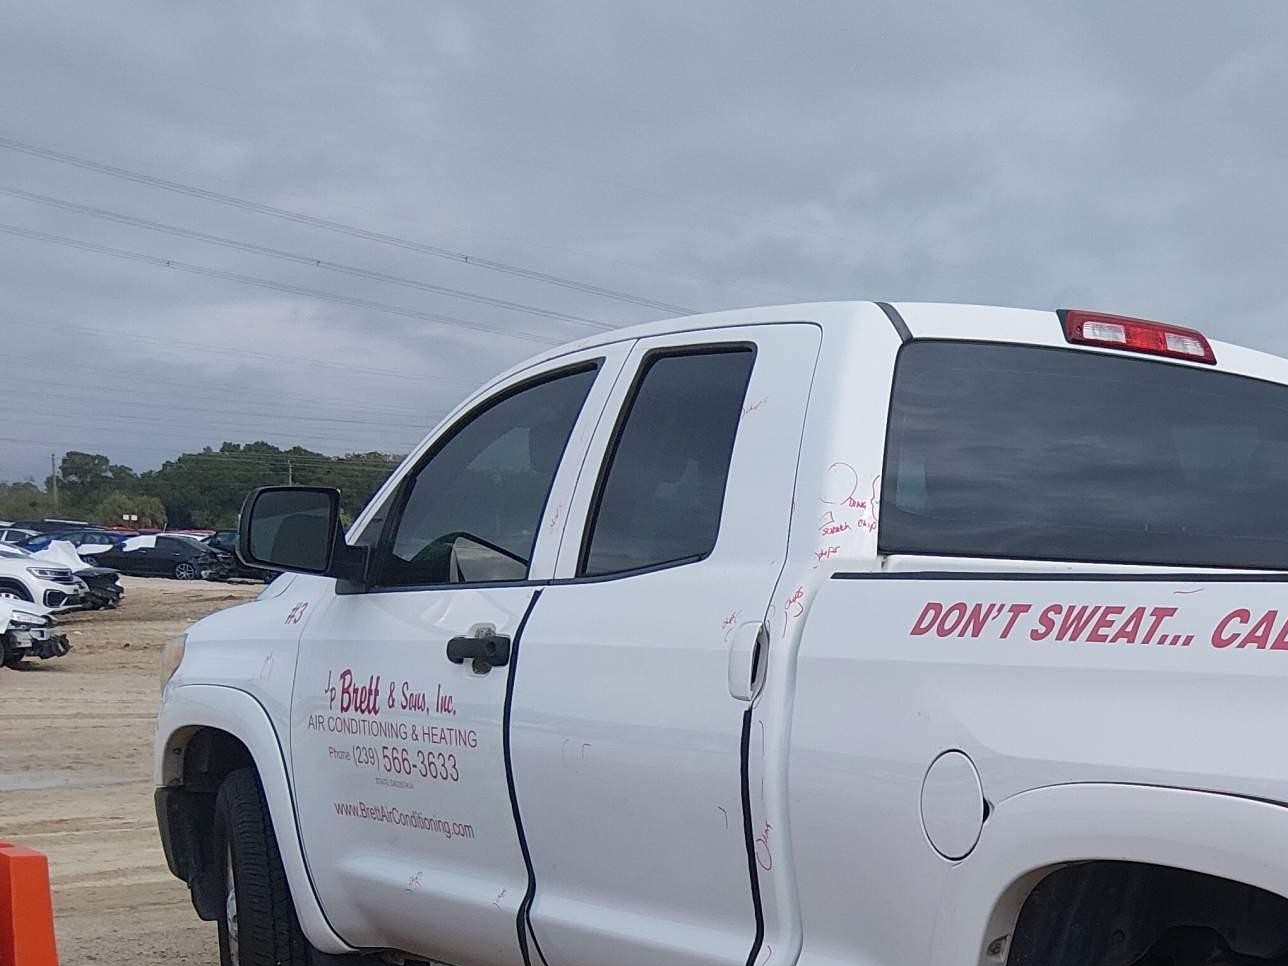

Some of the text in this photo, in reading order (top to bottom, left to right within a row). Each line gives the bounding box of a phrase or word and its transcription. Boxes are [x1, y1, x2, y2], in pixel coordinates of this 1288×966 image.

[909, 601, 1029, 637] DON'T
[1030, 604, 1196, 647] SWEAT...
[340, 668, 381, 716] Brett
[387, 681, 396, 709] &
[400, 681, 431, 716] Sons,
[436, 683, 457, 716] Inc.
[307, 714, 478, 749] AIR CONDITIONING & HEATING
[328, 745, 460, 782] Phone (239) 566-3633
[334, 801, 476, 839] www.BrettAirConditioning.com
